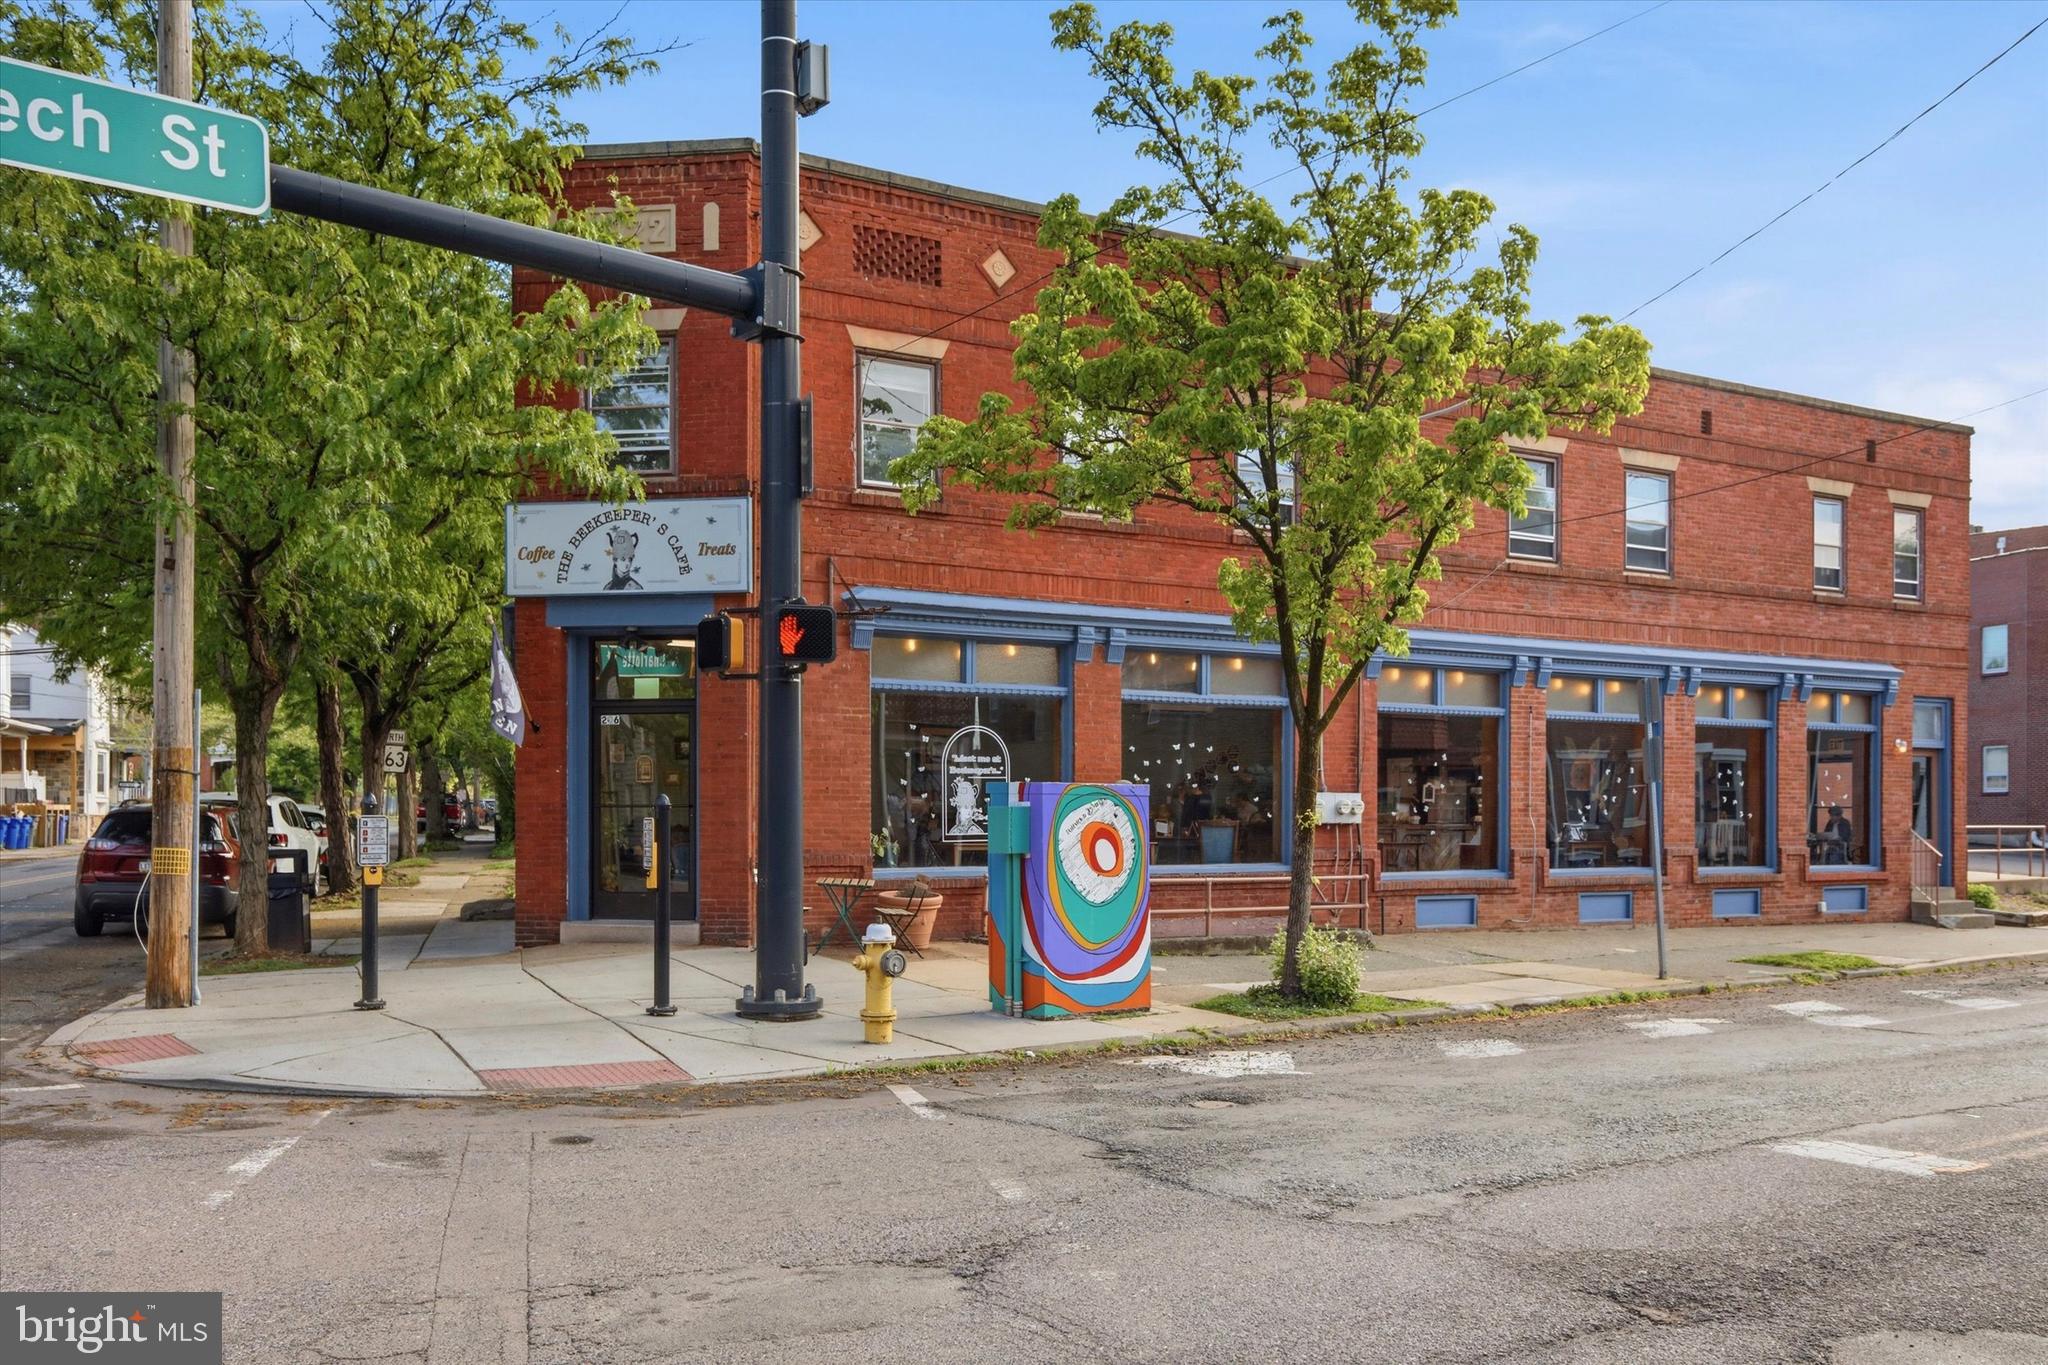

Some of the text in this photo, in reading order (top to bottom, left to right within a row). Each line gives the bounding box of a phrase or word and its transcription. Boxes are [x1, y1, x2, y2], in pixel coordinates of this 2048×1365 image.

[160, 114, 226, 177] St
[517, 546, 556, 564] Coffee
[556, 551, 574, 584] THE
[667, 534, 693, 576] CAFÉ
[698, 542, 737, 557] Treats
